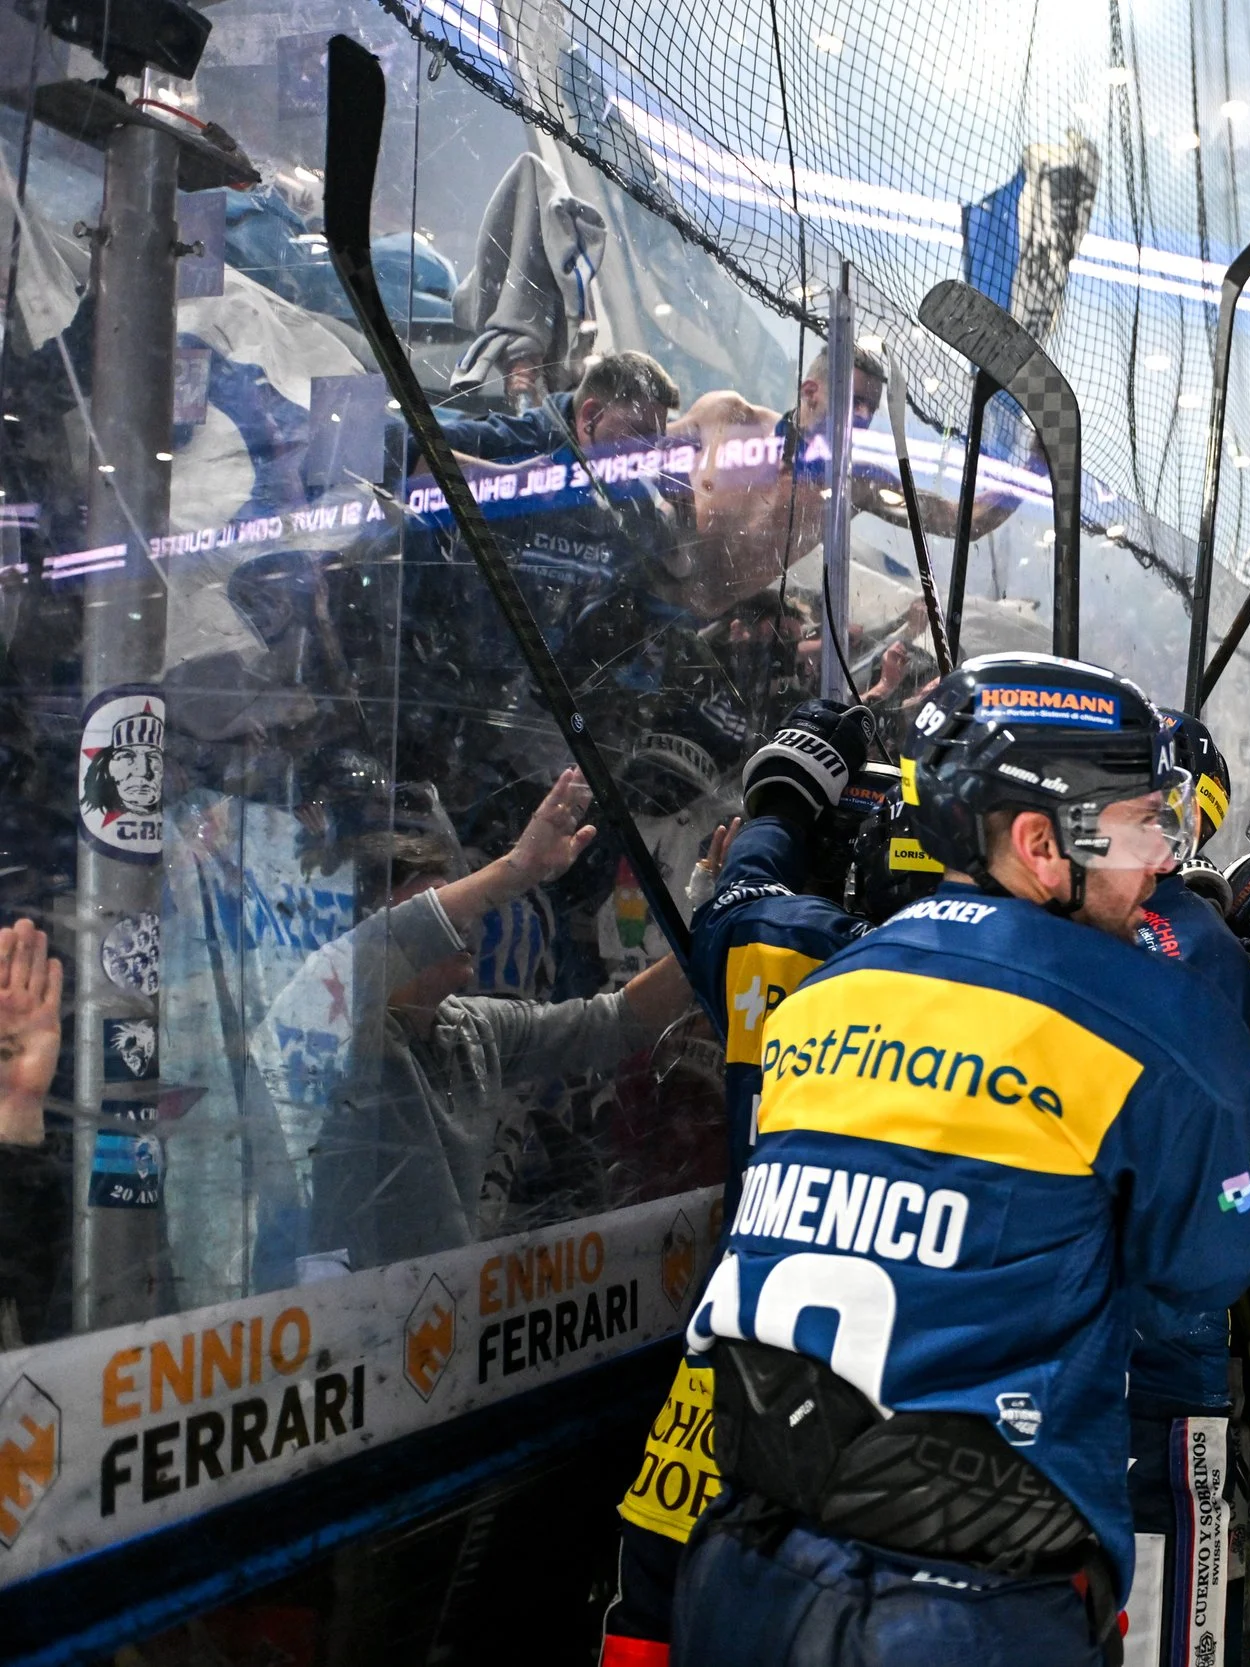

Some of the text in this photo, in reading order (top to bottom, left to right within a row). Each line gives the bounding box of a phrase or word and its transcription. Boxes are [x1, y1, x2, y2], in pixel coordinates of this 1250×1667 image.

[915, 701, 946, 736] 89
[981, 689, 1114, 715] HÖRMANN
[1200, 738, 1208, 754] 7
[890, 801, 905, 820] 17
[894, 850, 926, 859] LORIS
[763, 1023, 1063, 1118] PostFinance
[110, 1184, 133, 1202] 20
[479, 1230, 605, 1317] ENNIO
[479, 1279, 638, 1385] FERRARI
[101, 1306, 313, 1427] ENNIO
[101, 1364, 365, 1517] FERRARI
[915, 1435, 1050, 1499] COVE
[630, 1450, 721, 1518] D'OR
[1192, 1432, 1213, 1627] CUERVO Y SOBRINOS
[1212, 1537, 1222, 1585] SWISS
